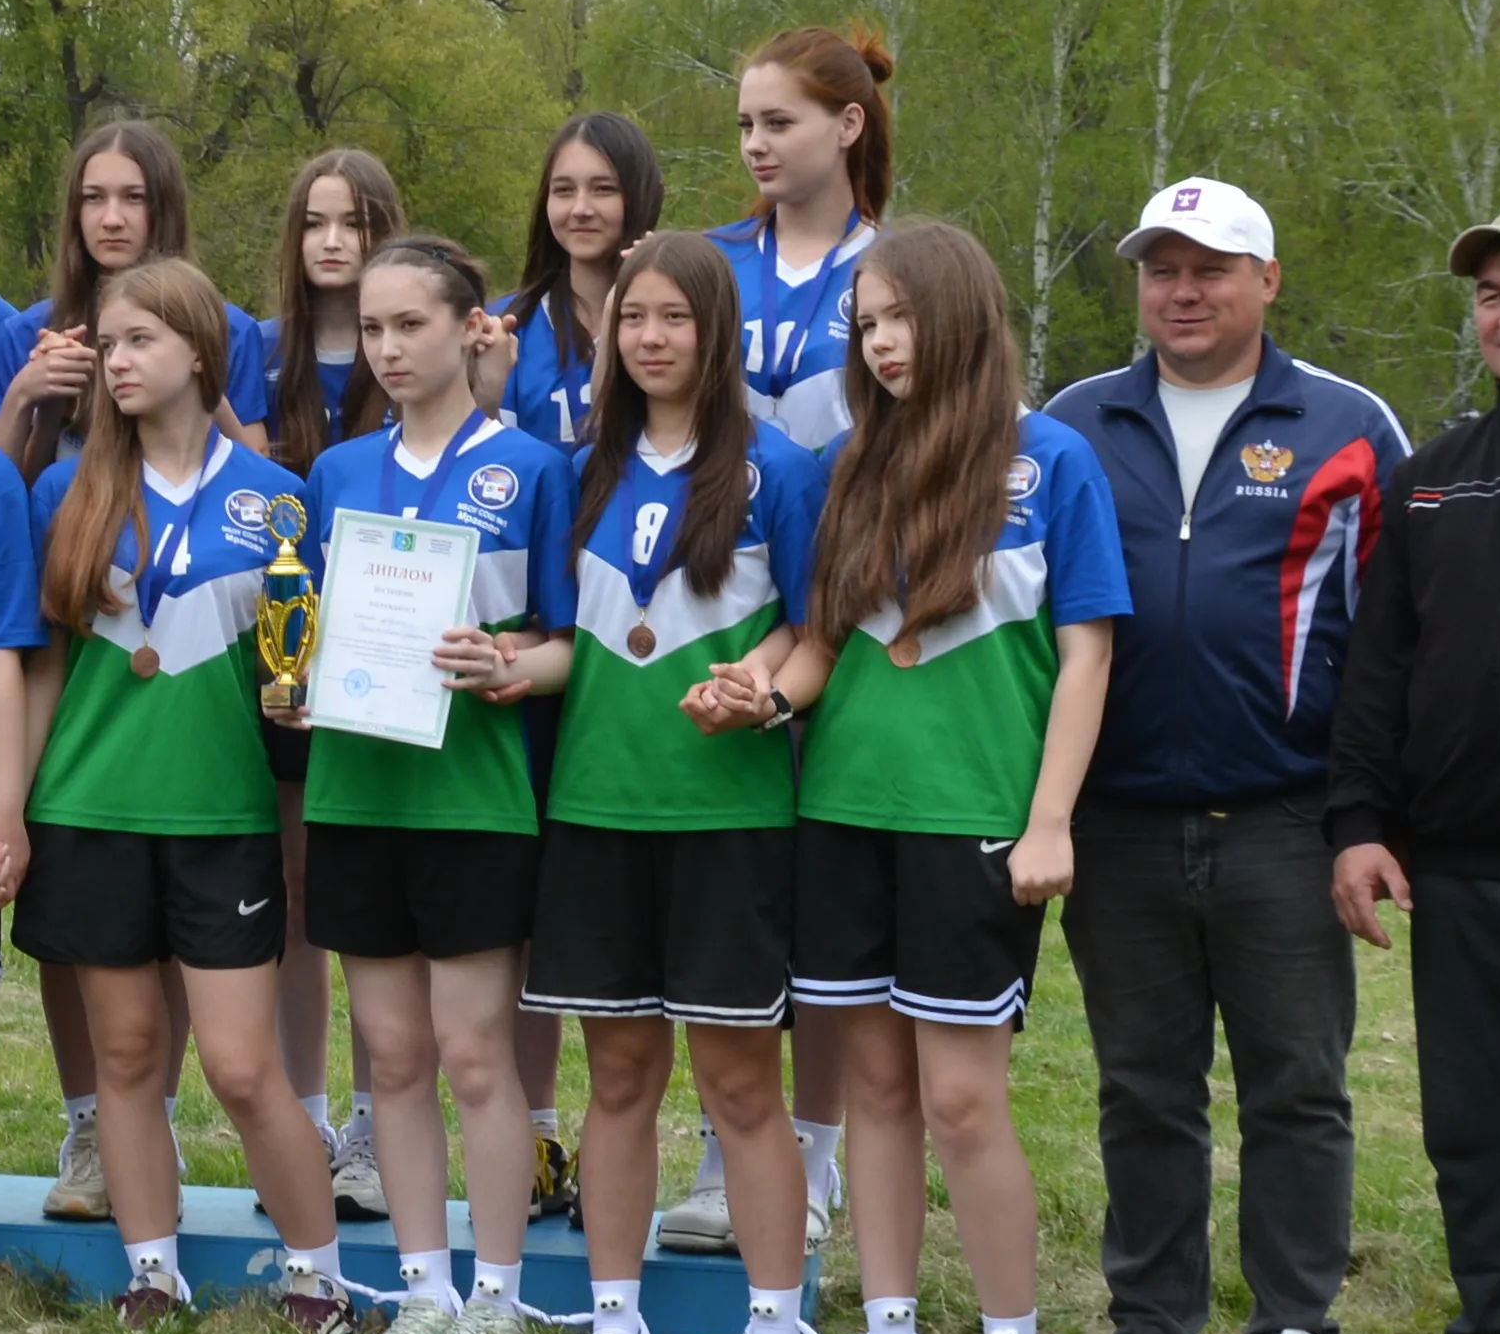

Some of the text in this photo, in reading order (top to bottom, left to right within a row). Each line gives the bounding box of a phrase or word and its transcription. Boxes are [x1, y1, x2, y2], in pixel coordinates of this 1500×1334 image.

[1235, 485, 1288, 499] RUSSIA
[632, 502, 669, 565] 8
[363, 562, 433, 583] ДИПЛОМ
